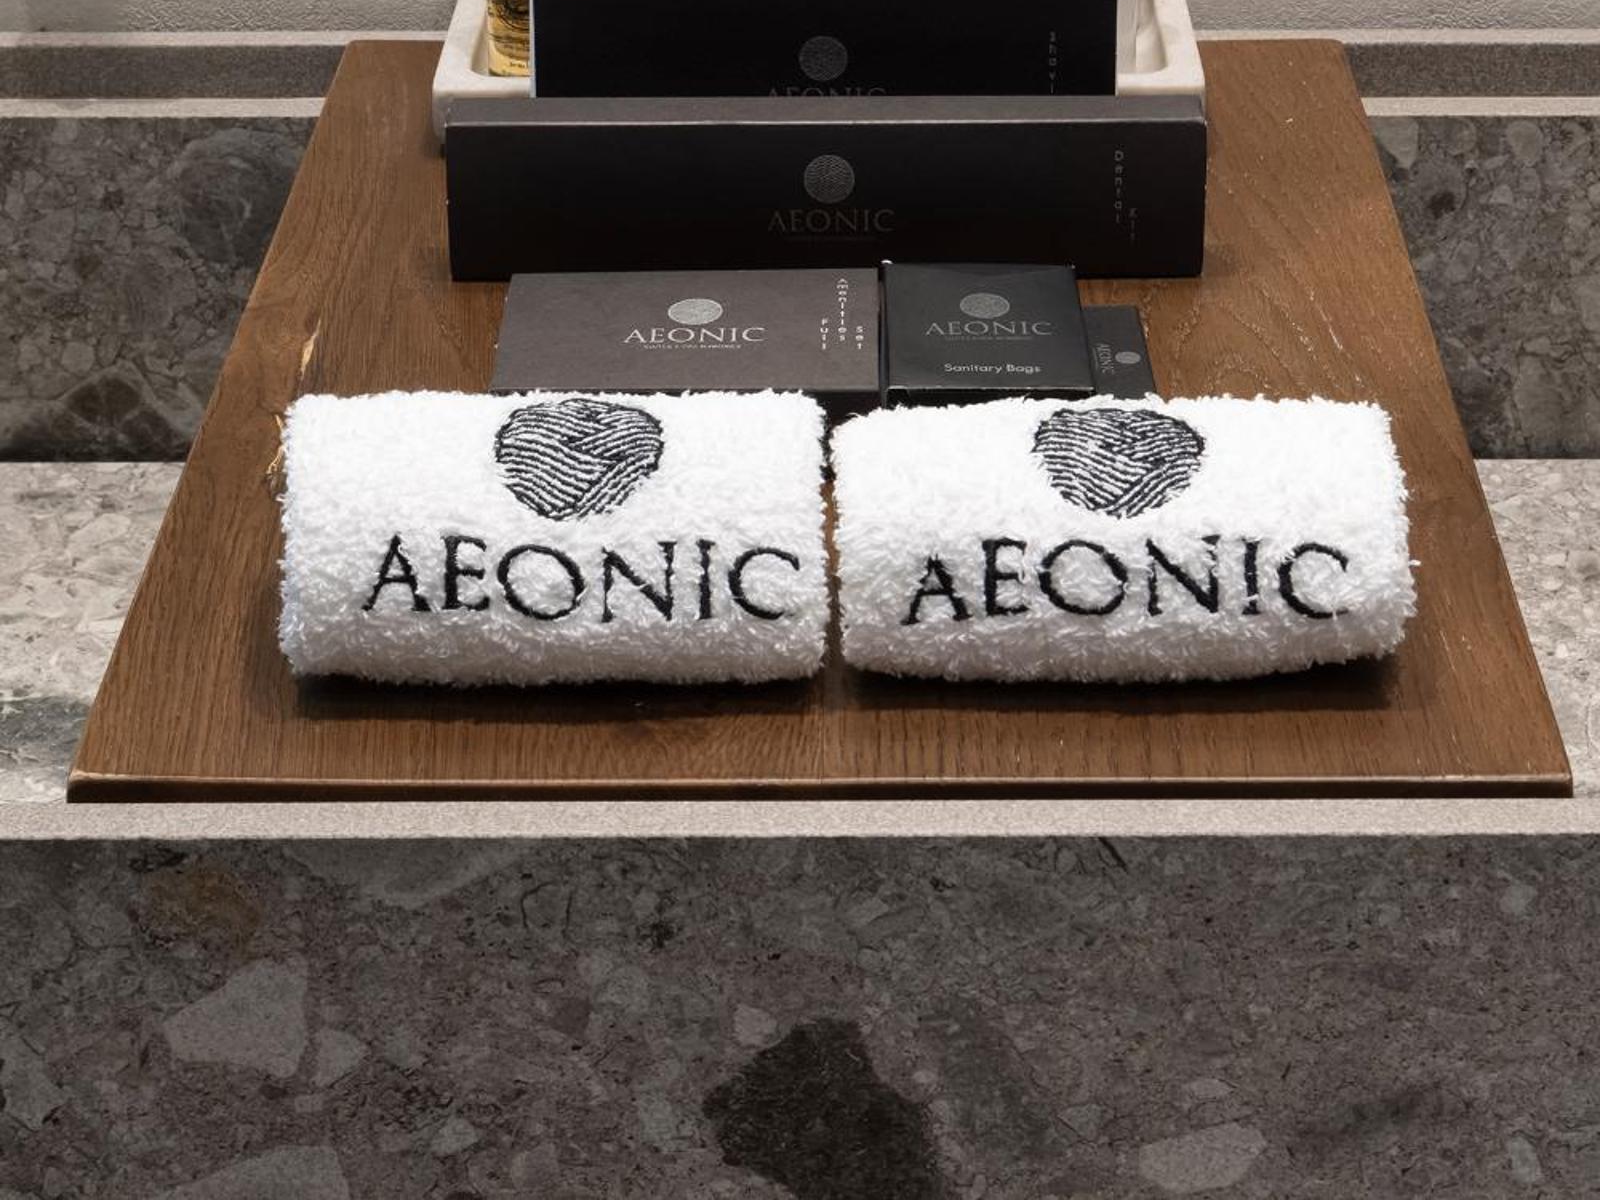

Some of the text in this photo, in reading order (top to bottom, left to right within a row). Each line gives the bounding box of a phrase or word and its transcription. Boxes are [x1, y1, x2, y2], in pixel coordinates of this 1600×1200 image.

[767, 208, 895, 232] AEONIC
[836, 278, 849, 342] Amenities
[624, 327, 766, 343] AEONIC
[819, 318, 829, 350] Full
[855, 326, 865, 350] Set
[925, 320, 1053, 336] AEONIC
[944, 362, 1041, 375] Sanitary Bags
[361, 534, 801, 623] AEONIC
[900, 534, 1350, 626] AEONIC
